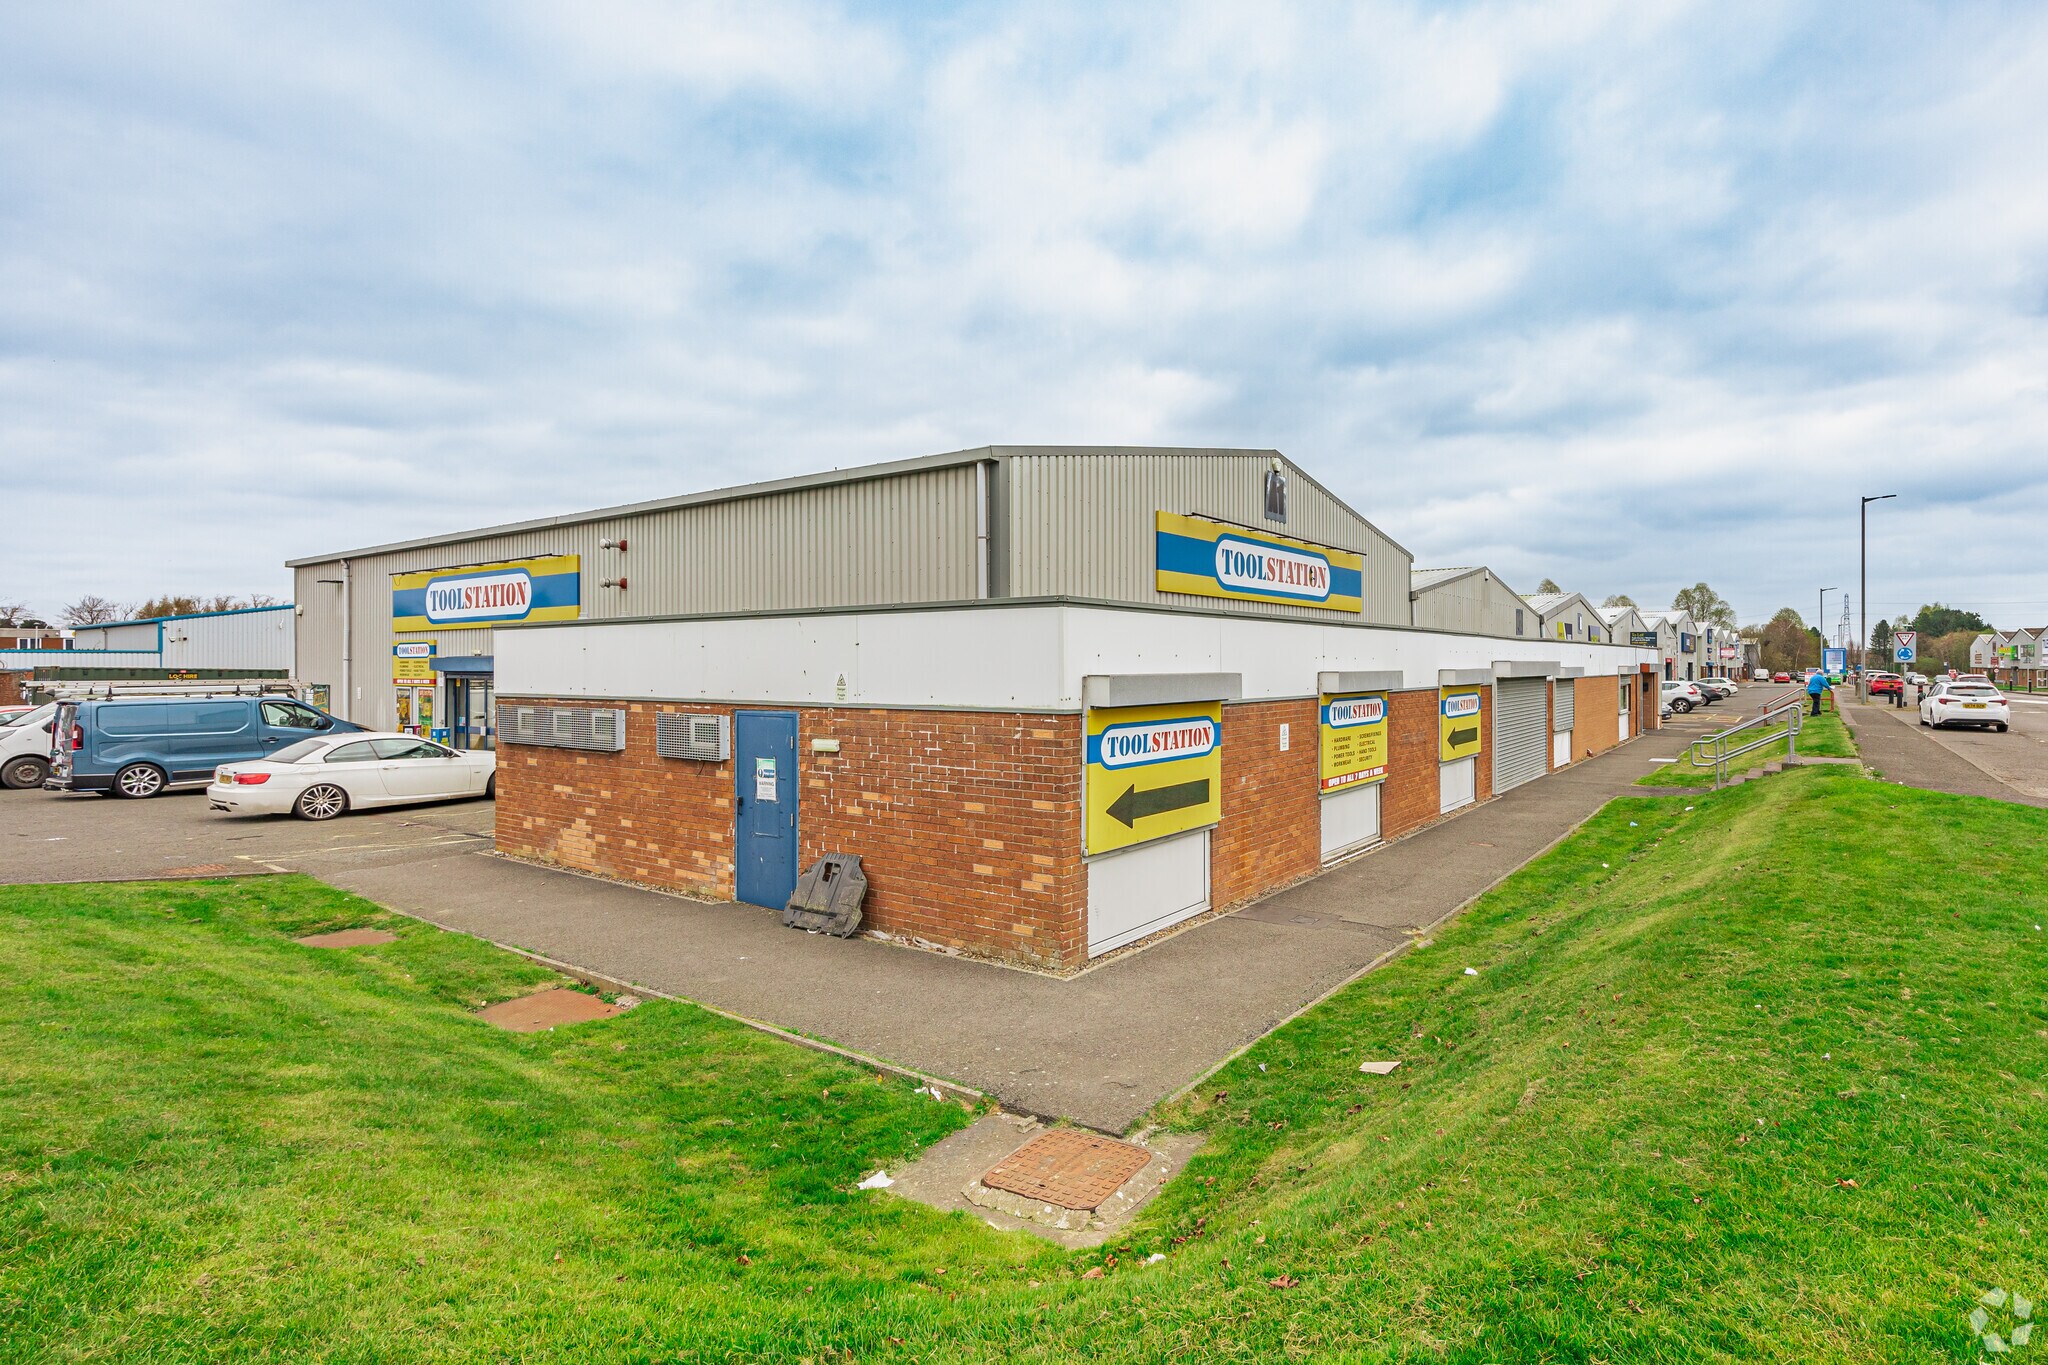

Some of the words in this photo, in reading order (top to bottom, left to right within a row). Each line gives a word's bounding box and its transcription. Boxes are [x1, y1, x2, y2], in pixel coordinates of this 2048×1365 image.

[1222, 549, 1326, 589] TOOLSTATION
[430, 582, 526, 612] TOOLSTATION
[398, 646, 428, 654] TOOLSTATION
[1332, 703, 1381, 720] TOOLSTATION
[1448, 698, 1477, 712] TOOLSTATION
[1107, 727, 1211, 757] TOOLSTATION
[1328, 778, 1340, 787] OPEN
[1359, 770, 1369, 779] DAYS
[1374, 767, 1383, 775] WEEK
